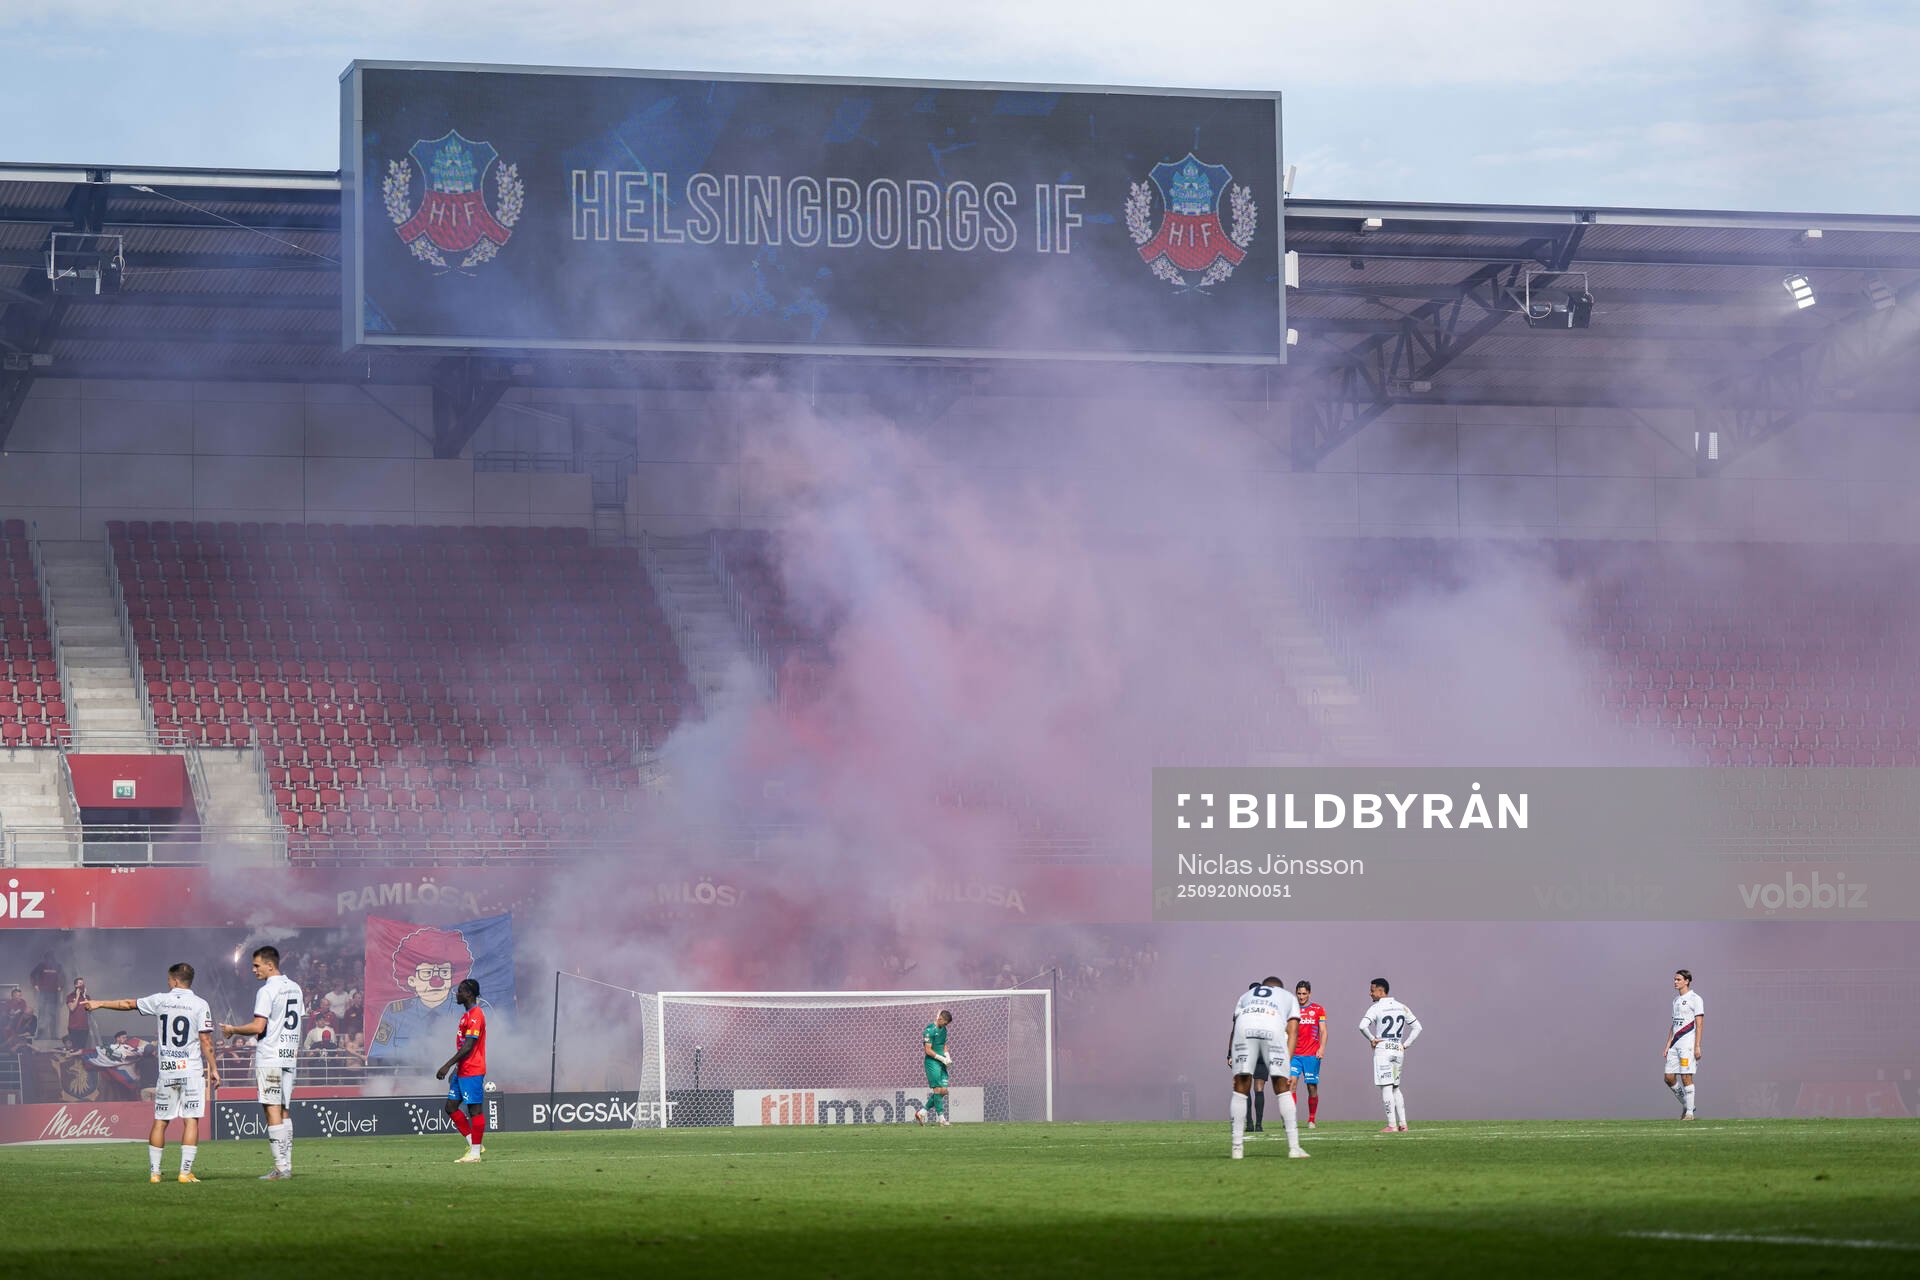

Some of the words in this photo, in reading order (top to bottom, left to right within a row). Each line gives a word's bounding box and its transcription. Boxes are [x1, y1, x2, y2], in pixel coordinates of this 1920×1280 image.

[572, 169, 1018, 253] HELSINGBORGS
[1036, 183, 1086, 254] IF
[1168, 222, 1212, 248] HIF
[0, 878, 45, 919] iz
[337, 876, 481, 916] RAMLÖSA
[1737, 871, 1868, 909] vobbiz
[1253, 986, 1272, 998] 6
[284, 999, 298, 1030] 5
[1382, 1014, 1405, 1038] 22
[160, 1014, 190, 1047] 19
[160, 1049, 190, 1058] NDREASSON
[38, 1104, 113, 1139] Melitta
[233, 1113, 269, 1135] Valv
[326, 1111, 378, 1133] Valvet
[416, 1109, 458, 1131] Valv
[488, 1100, 498, 1130] SELECT
[533, 1097, 678, 1124] BYGGSÄKERT
